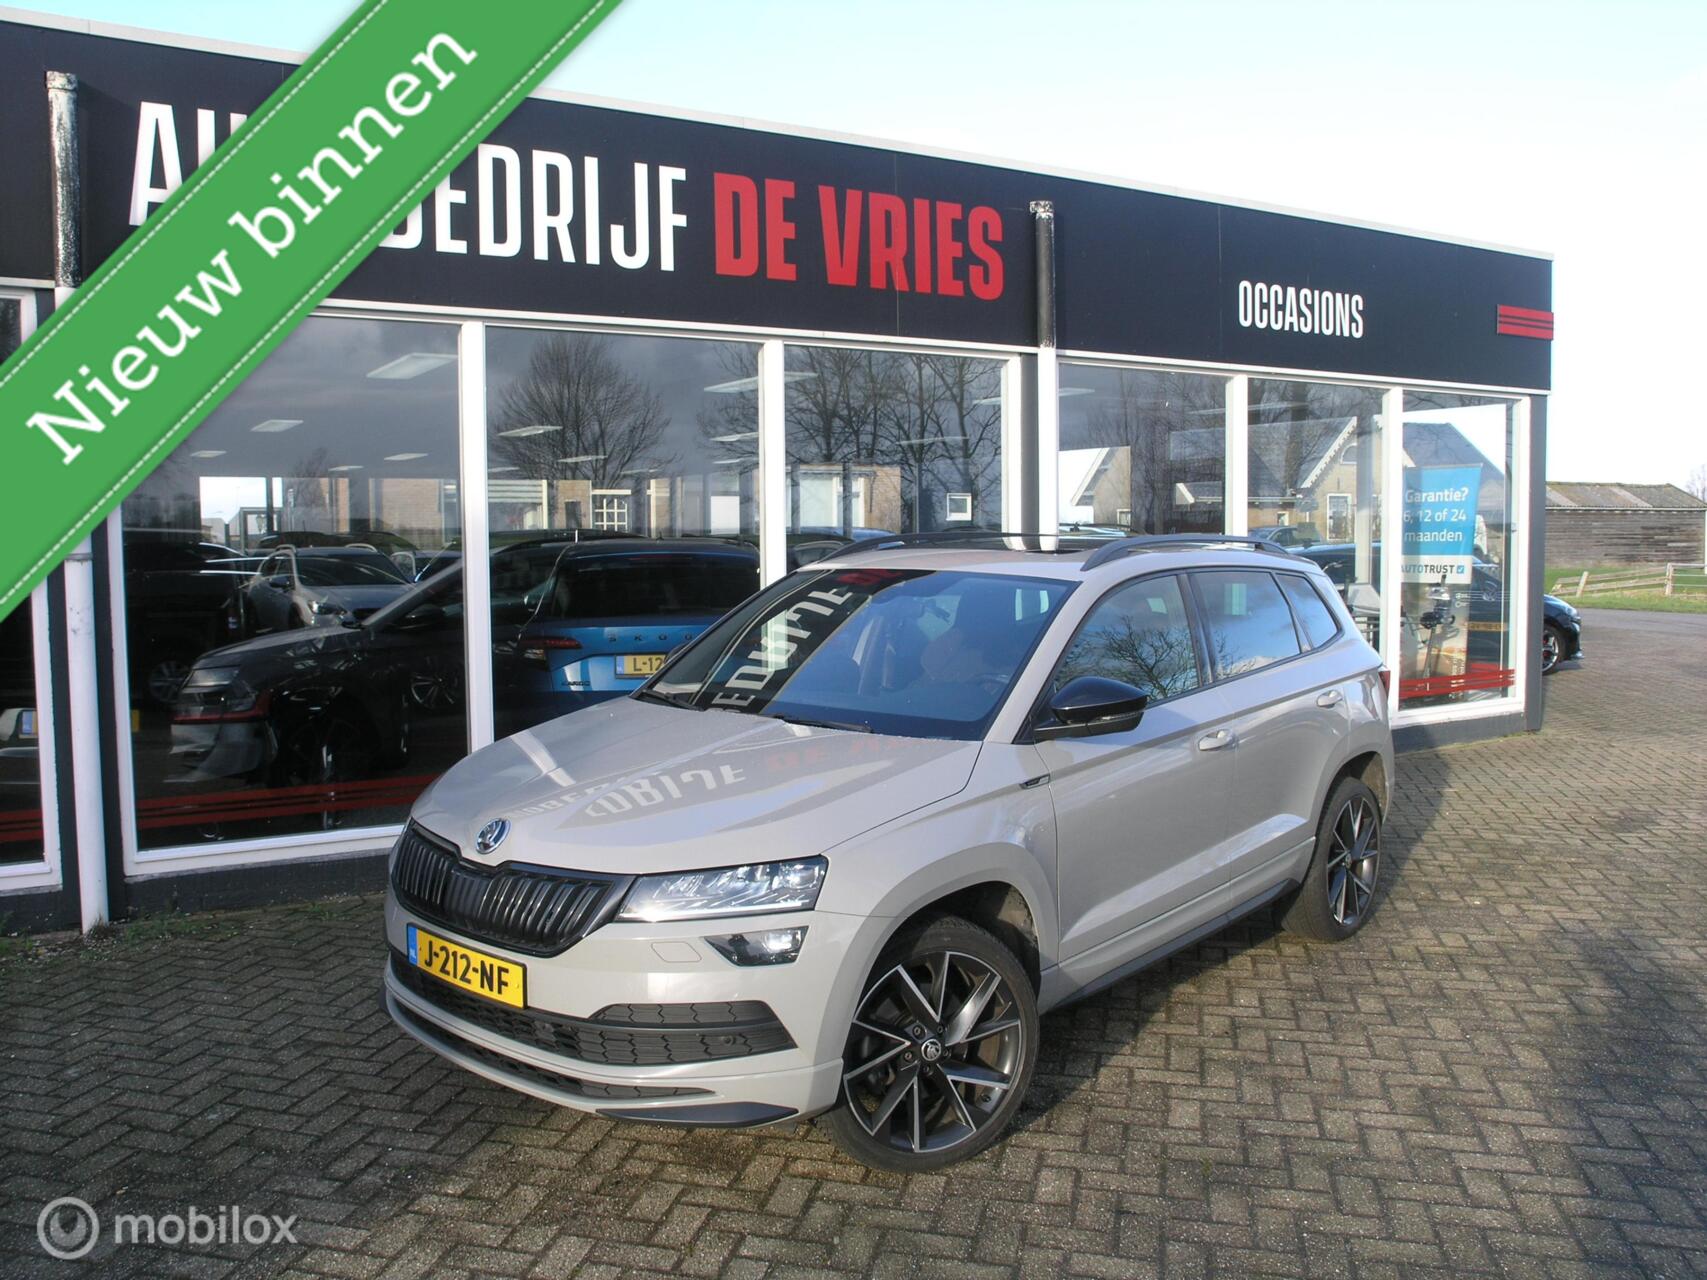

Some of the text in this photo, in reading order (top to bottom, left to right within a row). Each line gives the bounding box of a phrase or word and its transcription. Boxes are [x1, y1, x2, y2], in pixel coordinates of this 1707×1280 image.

[713, 172, 797, 281] DE
[818, 185, 1004, 301] VRIES
[1238, 280, 1363, 339] OCCASIONS
[1405, 487, 1469, 503] Garantie?
[1418, 509, 1432, 522] 12
[1434, 508, 1448, 522] of
[1450, 509, 1467, 522] 24
[1404, 529, 1463, 542] maanden
[633, 657, 666, 672] L-12
[424, 940, 509, 995] J-212-NF
